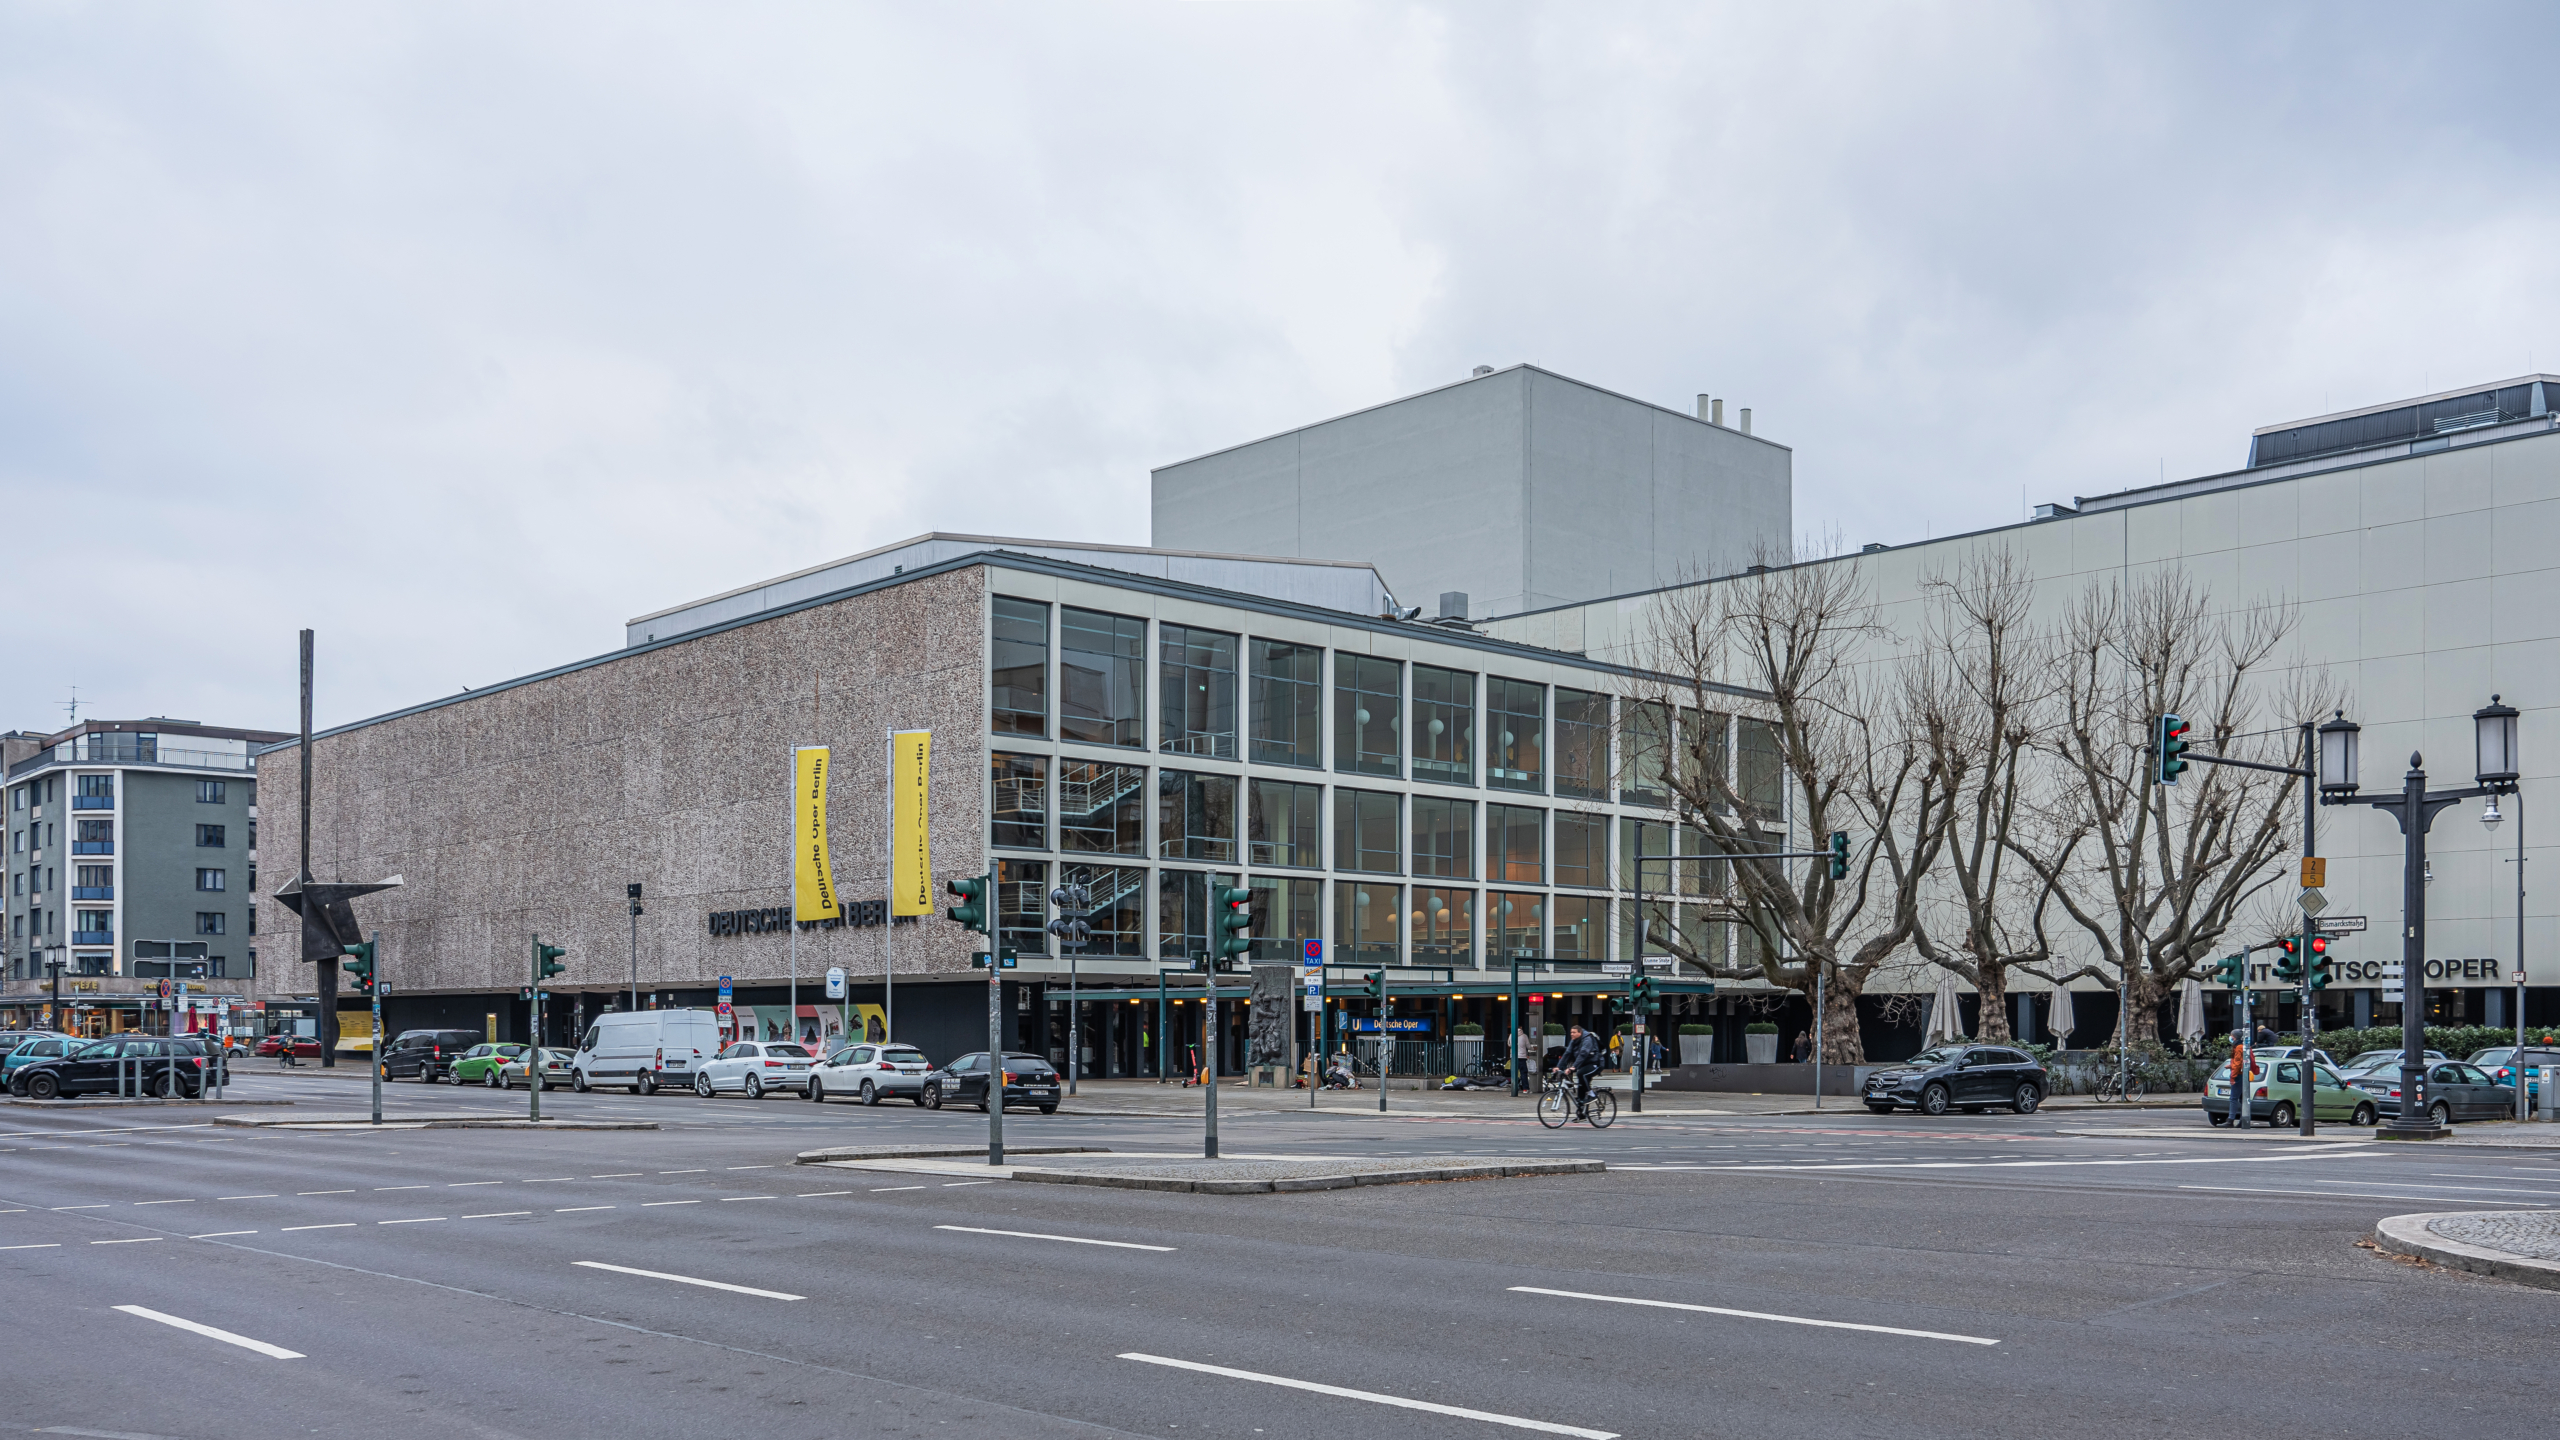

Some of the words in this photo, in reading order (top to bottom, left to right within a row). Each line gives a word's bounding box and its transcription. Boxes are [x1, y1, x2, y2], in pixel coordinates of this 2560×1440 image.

[812, 758, 822, 799] Berlin
[2310, 861, 2316, 870] 2
[2310, 875, 2316, 884] 5
[709, 906, 792, 935] DEUTSCHE
[2424, 958, 2498, 978] OPER
[1352, 1019, 1360, 1030] U
[1374, 1019, 1402, 1028] Detsche
[1403, 1020, 1418, 1030] Oper
